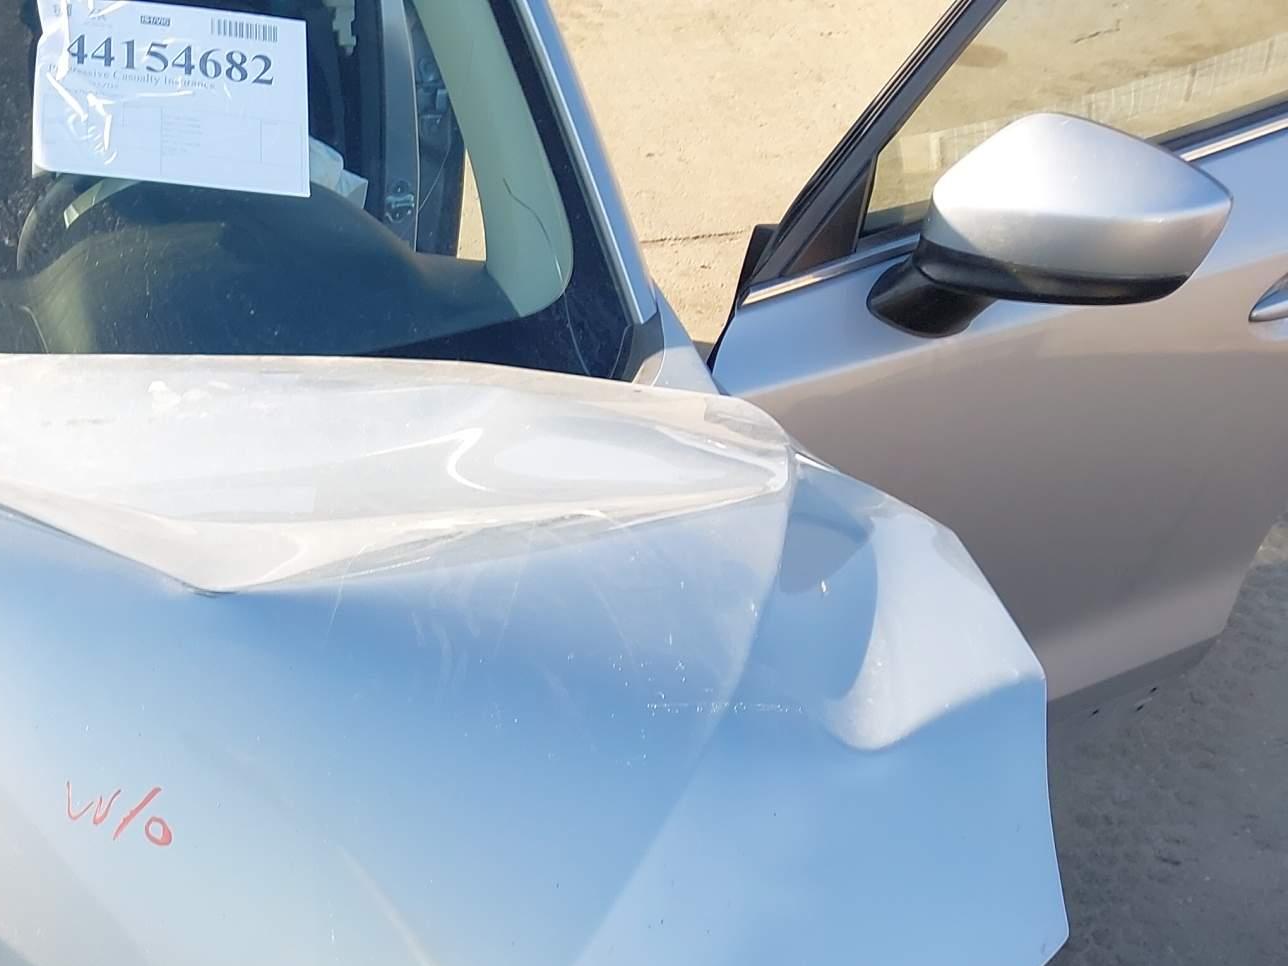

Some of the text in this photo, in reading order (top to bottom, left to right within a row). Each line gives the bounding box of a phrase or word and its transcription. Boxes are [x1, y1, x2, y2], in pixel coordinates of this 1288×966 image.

[48, 63, 111, 80] Prressive
[112, 71, 161, 86] Casualty
[66, 33, 275, 86] 44154682
